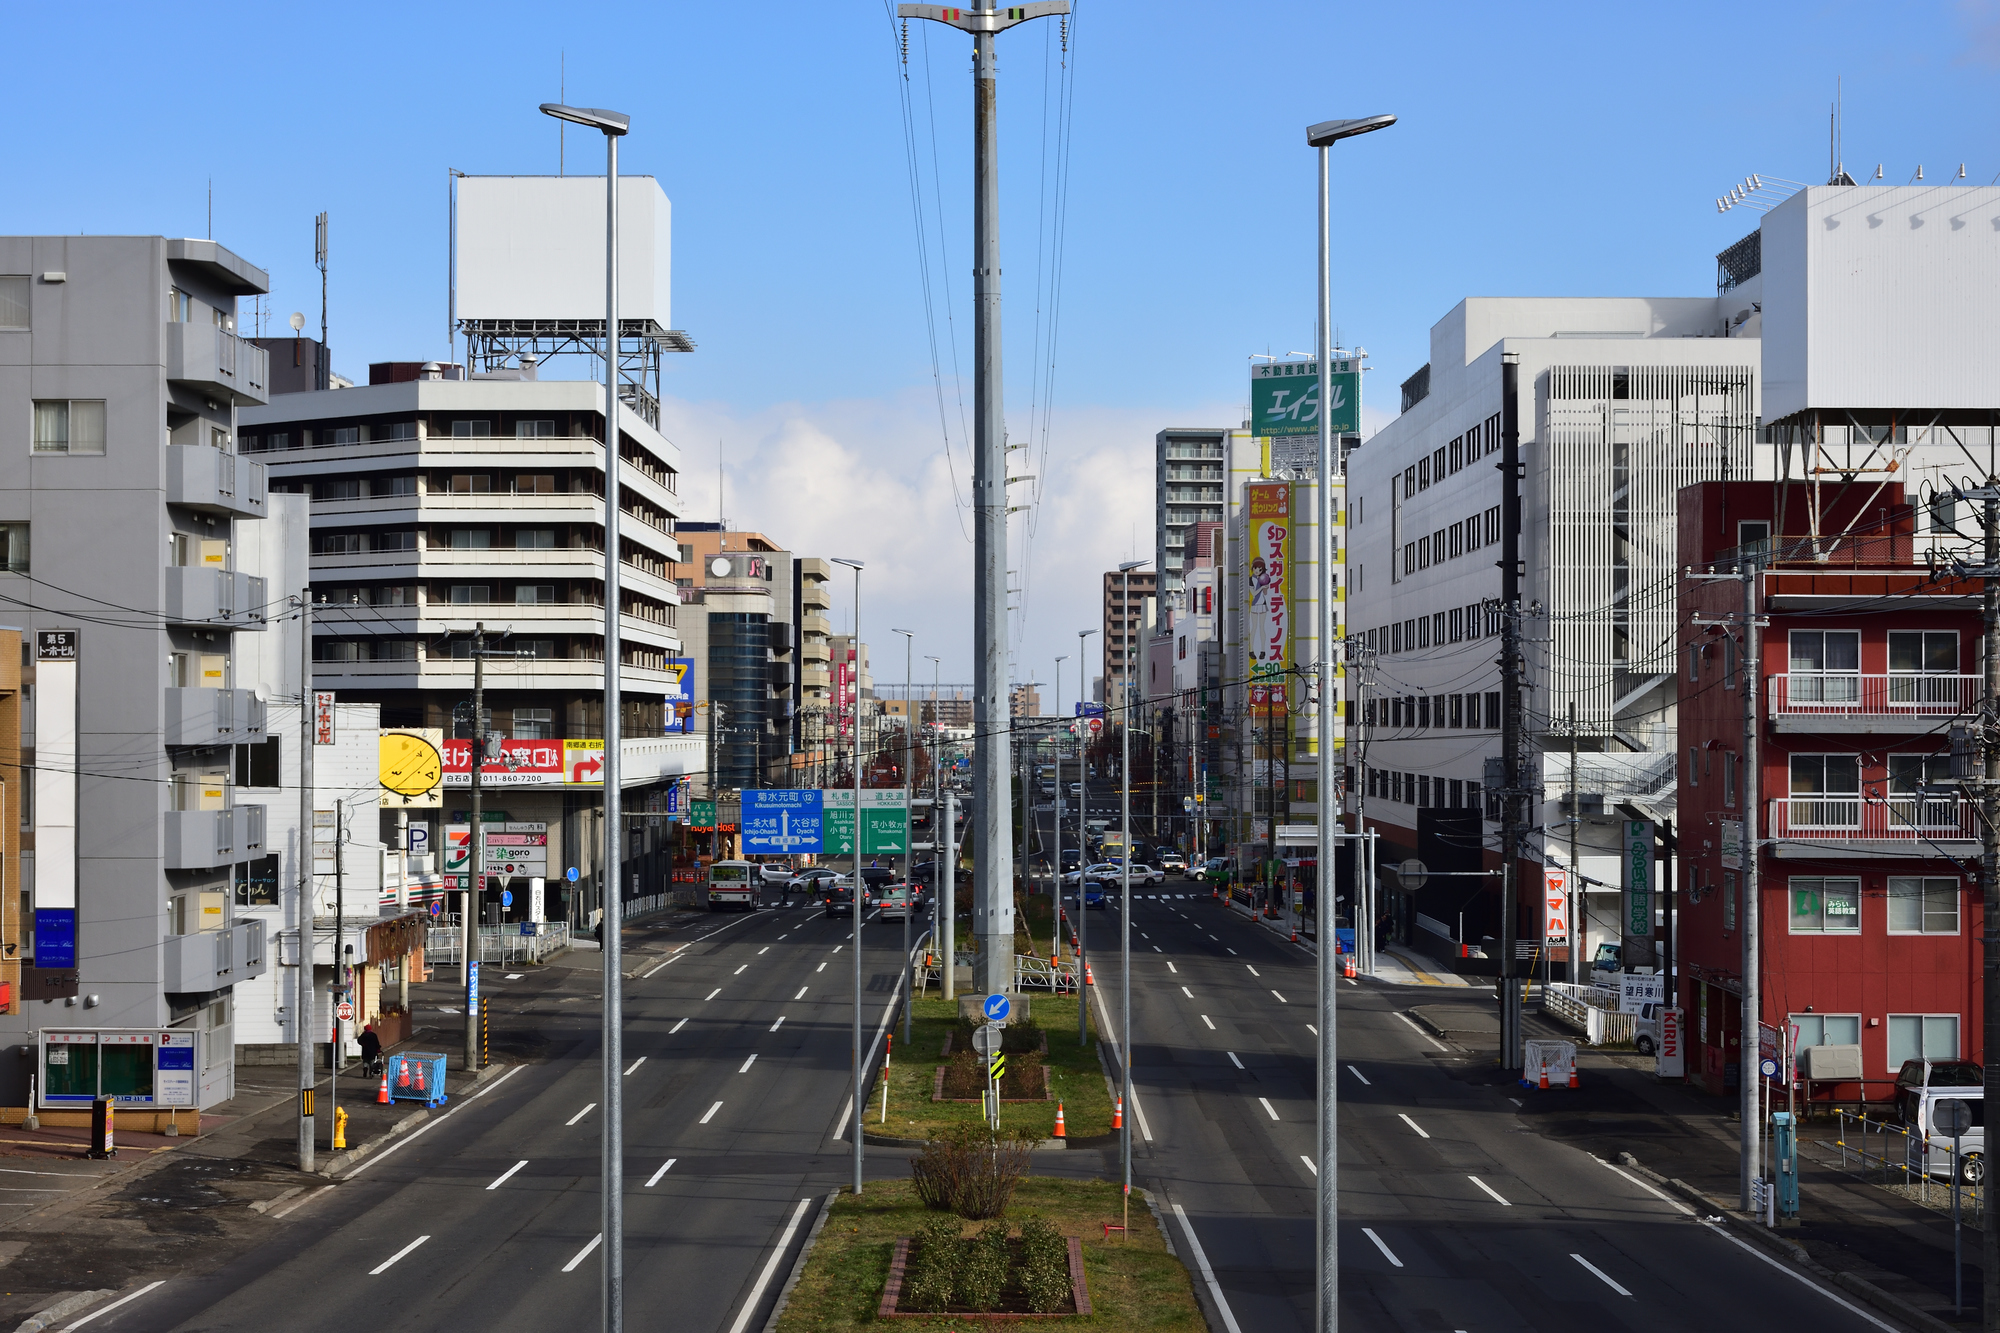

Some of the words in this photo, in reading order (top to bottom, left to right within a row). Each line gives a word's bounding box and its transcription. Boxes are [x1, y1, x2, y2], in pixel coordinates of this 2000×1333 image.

[1261, 361, 1350, 378] 不動産賃貸管理
[1261, 423, 1350, 434] http://www.abco.jp
[1252, 489, 1270, 500] ゲーム
[1252, 502, 1278, 514] ボウリング
[46, 634, 66, 644] 第5
[40, 646, 75, 656] トーホービル
[757, 792, 799, 802] 菊水元町
[718, 823, 736, 832] Host
[744, 818, 777, 828] 一条大橋
[792, 818, 820, 828] 大谷地
[410, 828, 428, 851] P
[508, 849, 530, 857] goro
[444, 878, 457, 888] ATM
[1632, 842, 1648, 935] みらい英語学校
[1548, 878, 1564, 930] ヤマハ
[1625, 986, 1664, 998] 望月寒川
[162, 1034, 171, 1045] P
[1664, 1012, 1676, 1056] KIRIN
